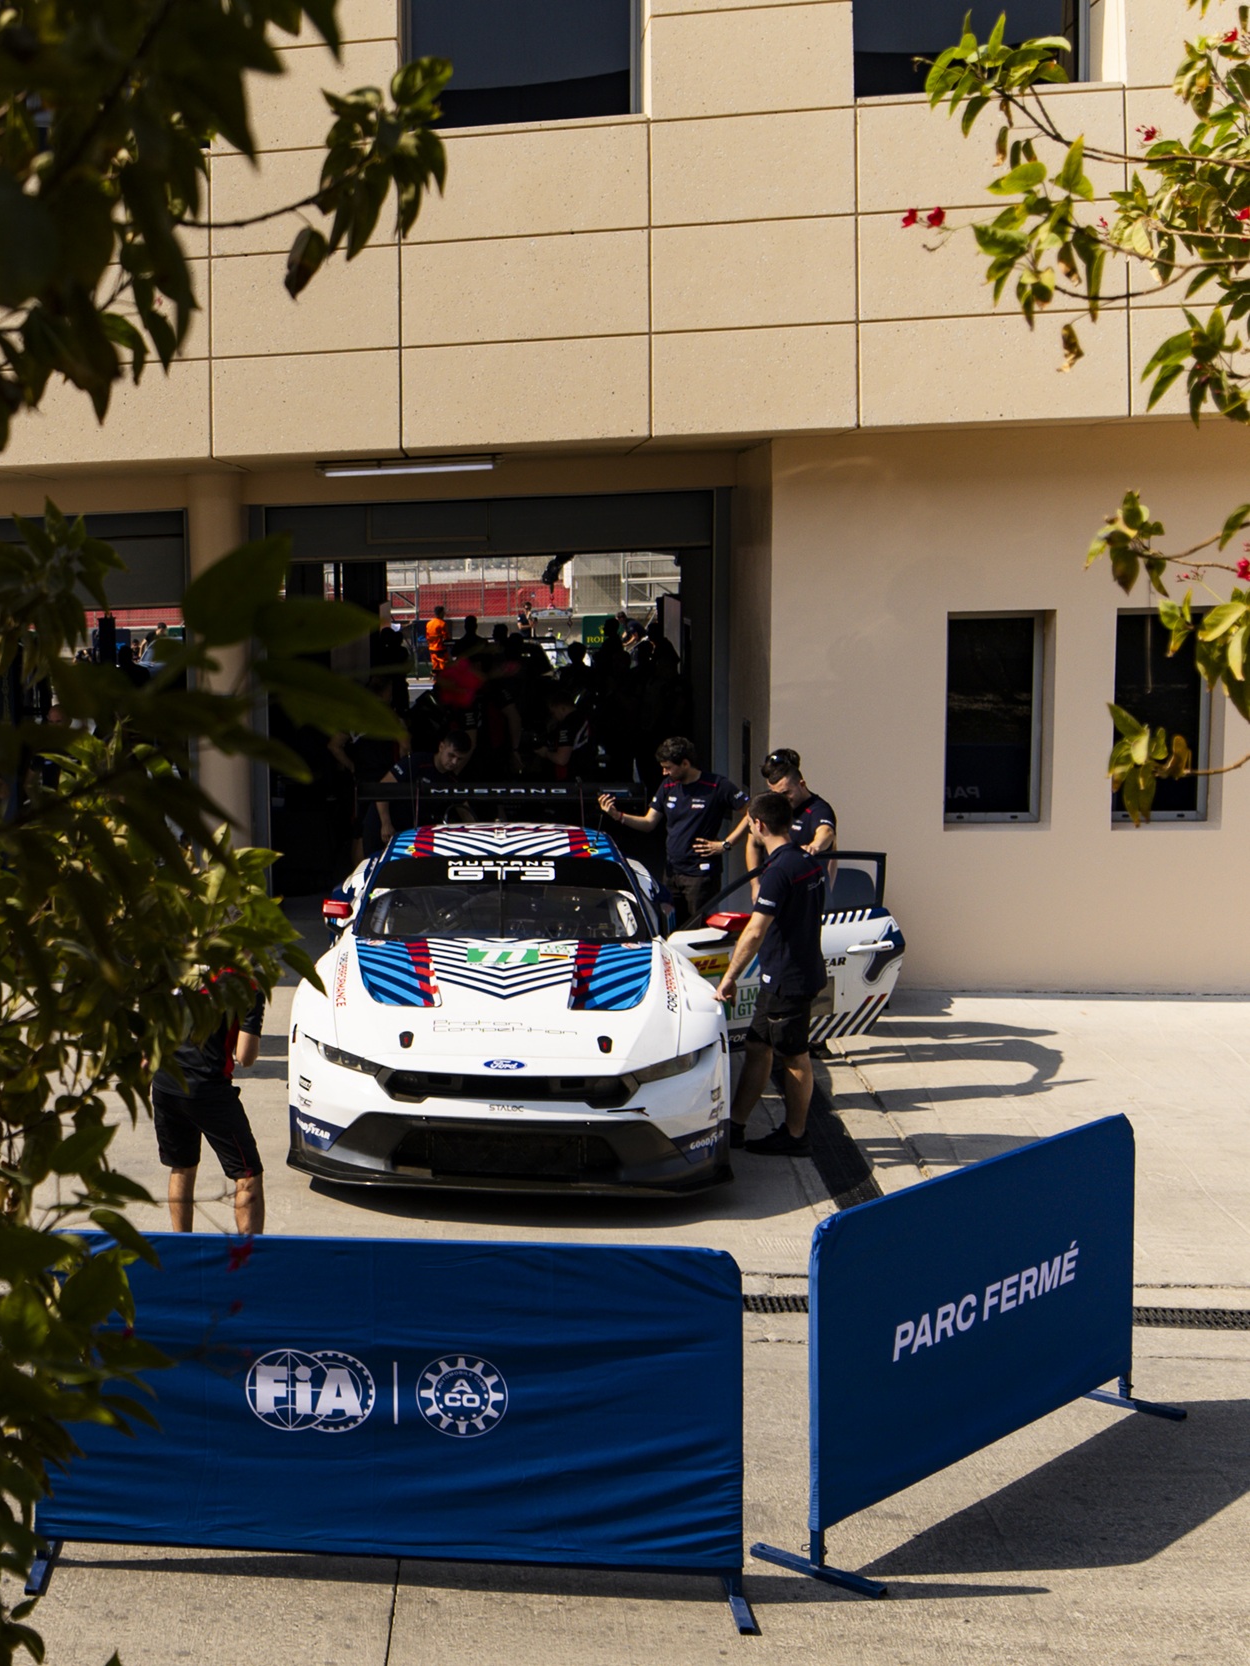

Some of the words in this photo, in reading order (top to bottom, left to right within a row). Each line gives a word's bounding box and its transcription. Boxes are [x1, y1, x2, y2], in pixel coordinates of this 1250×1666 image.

[447, 866, 556, 881] GT3
[478, 948, 528, 963] 77
[737, 1002, 755, 1017] GT
[490, 1060, 519, 1070] Ford
[489, 1103, 525, 1113] STALOC
[893, 1294, 977, 1362] PARC
[983, 1240, 1079, 1321] FERMÉ
